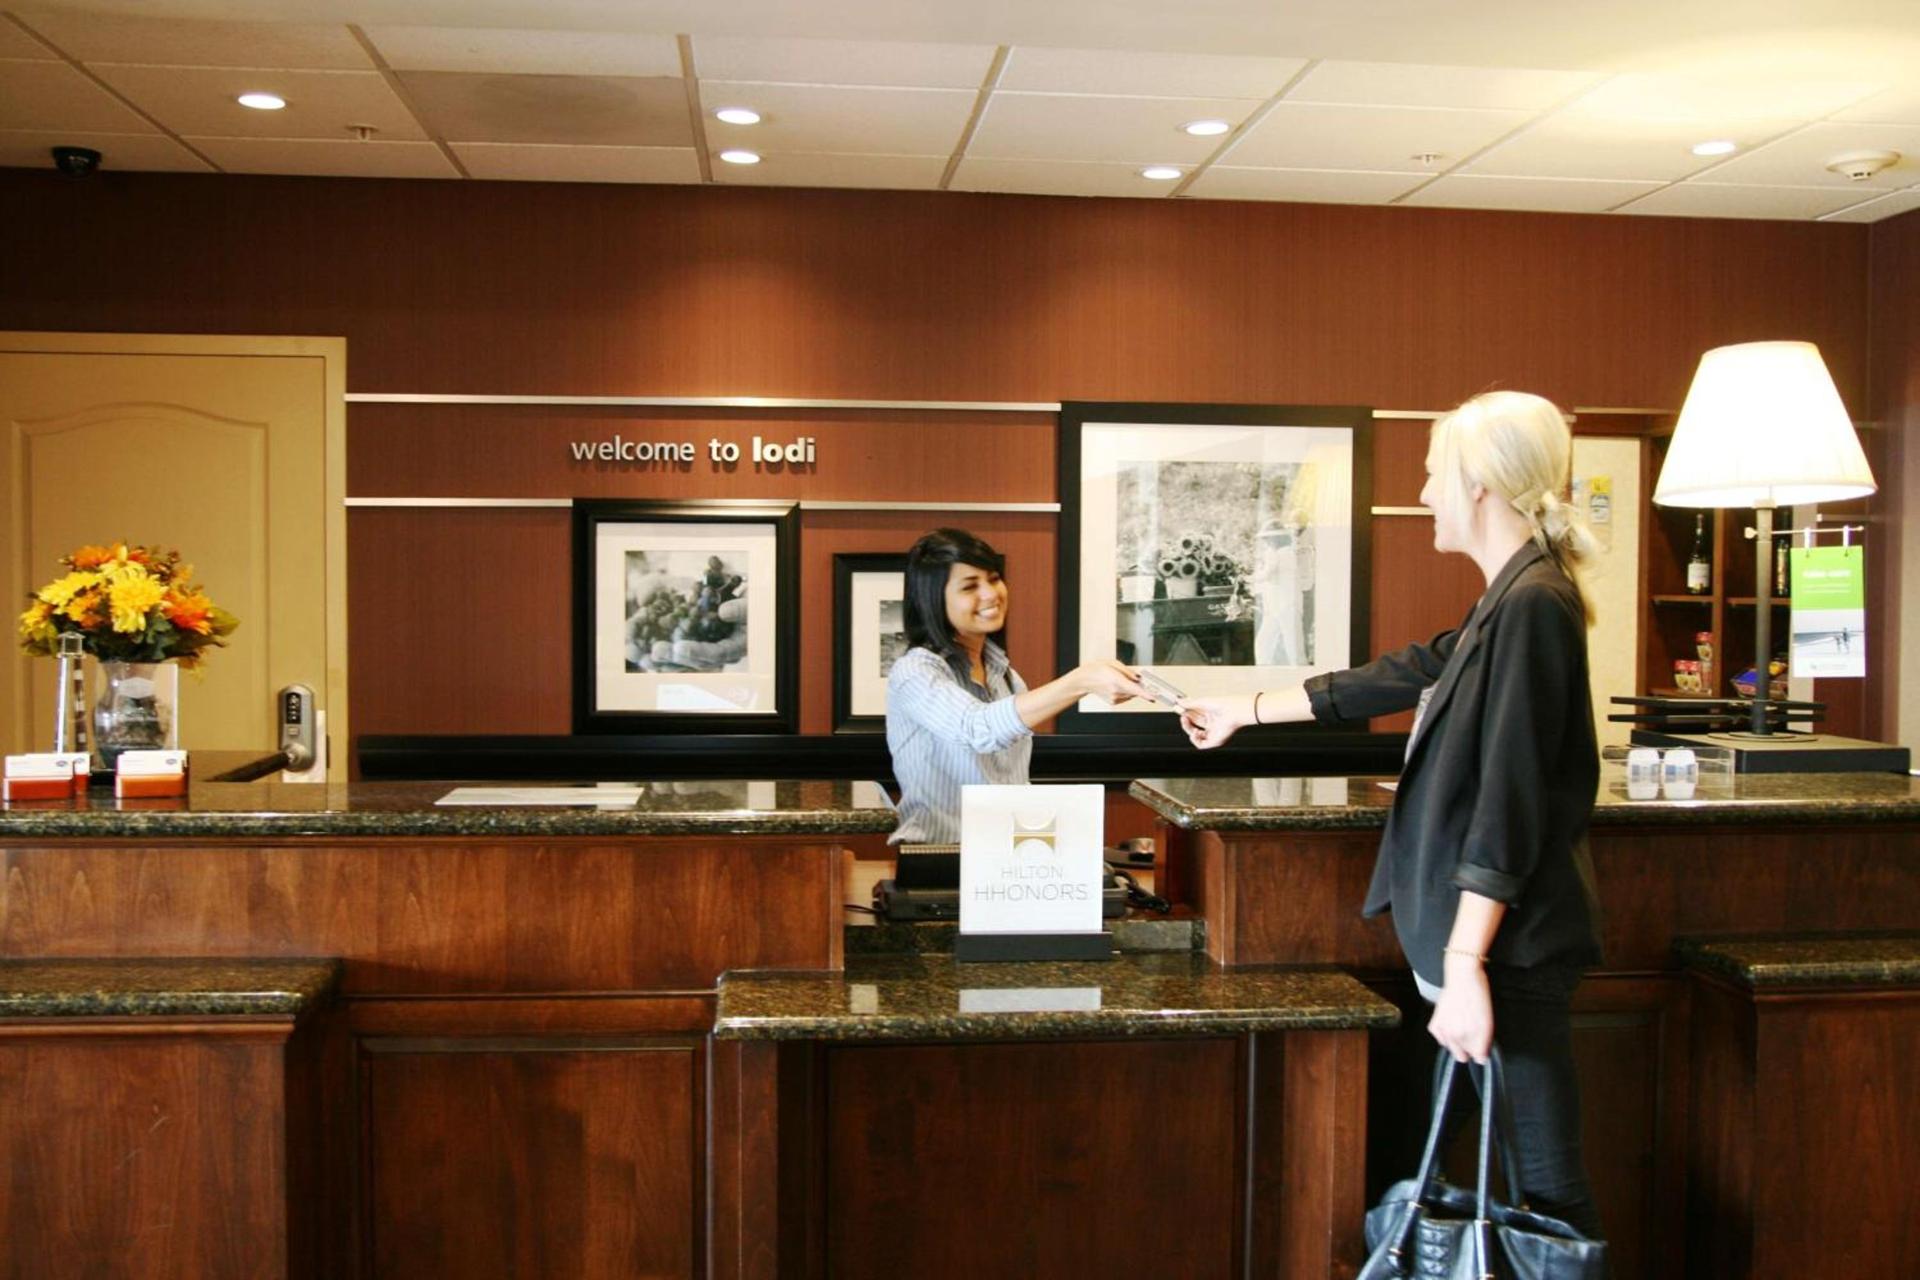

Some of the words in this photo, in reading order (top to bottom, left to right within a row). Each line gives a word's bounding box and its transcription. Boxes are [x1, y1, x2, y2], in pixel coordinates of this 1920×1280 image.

[571, 435, 695, 461] welcome
[709, 437, 740, 462] to
[752, 436, 815, 463] lodi
[1001, 865, 1063, 880] HILTON
[975, 884, 1088, 901] HHONORS
